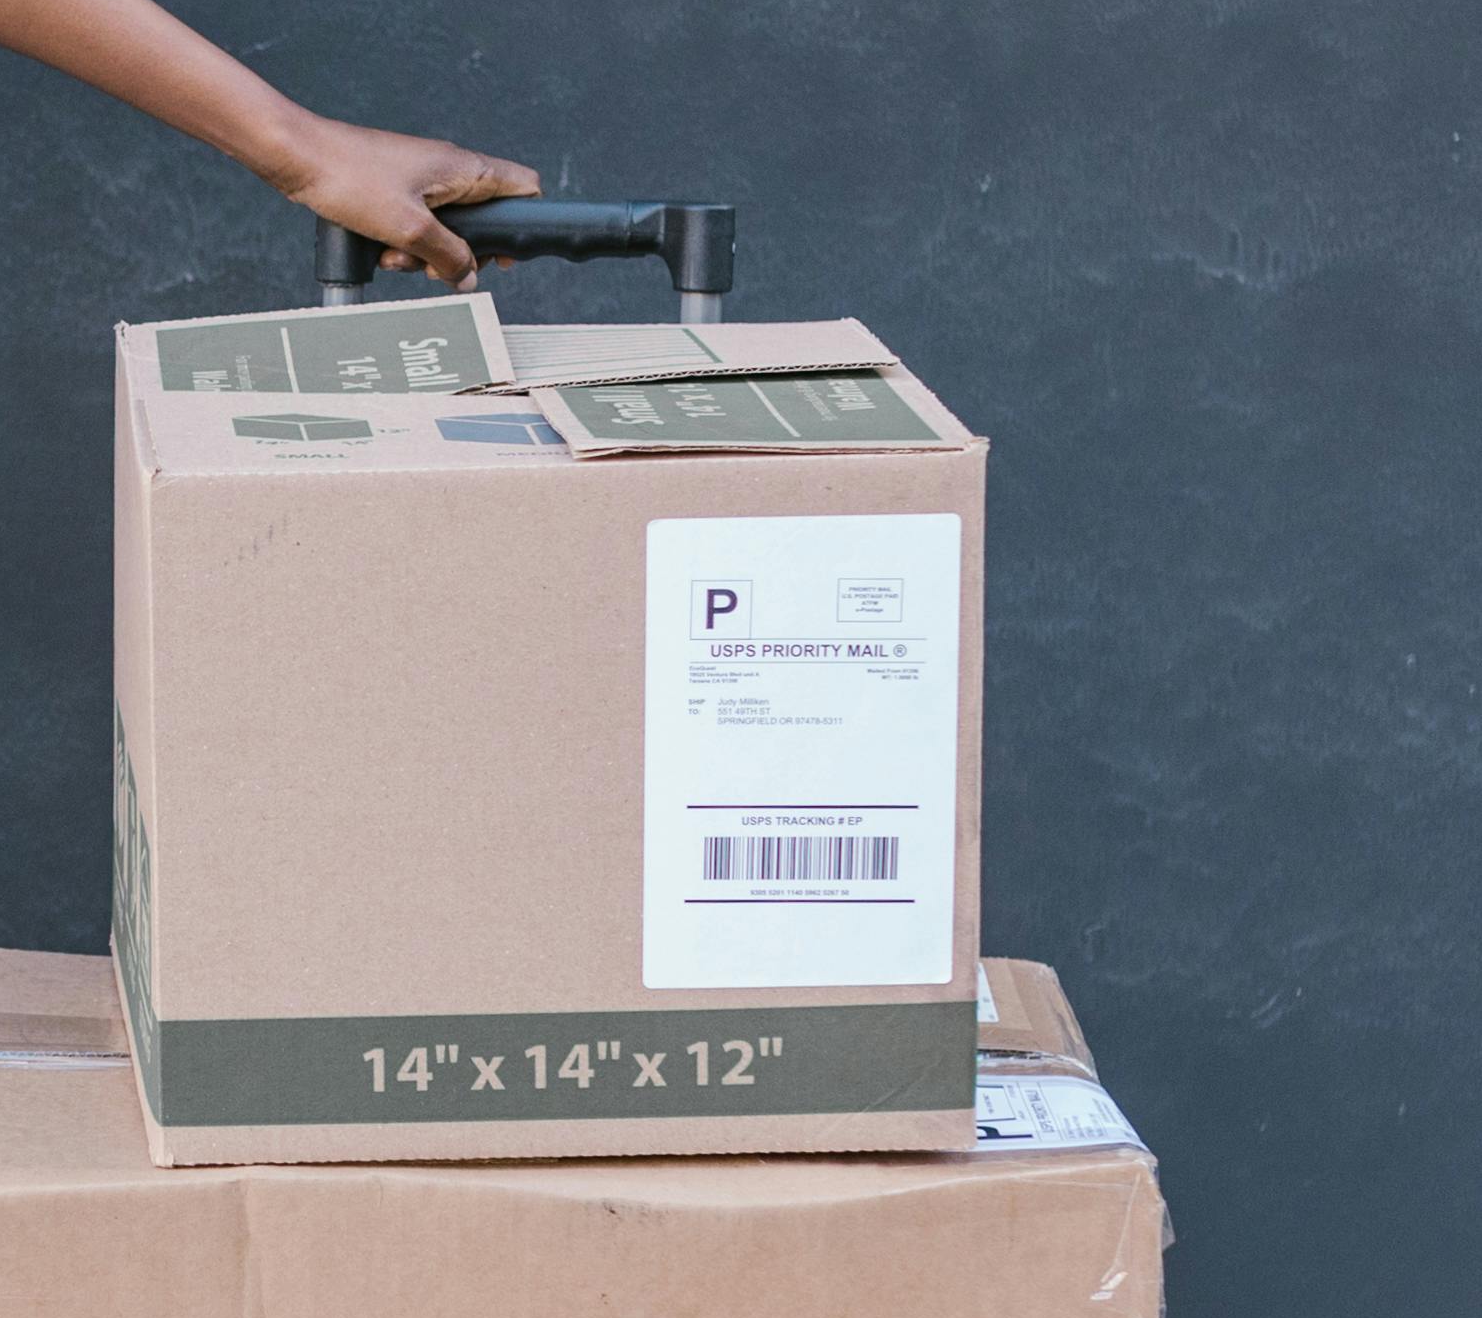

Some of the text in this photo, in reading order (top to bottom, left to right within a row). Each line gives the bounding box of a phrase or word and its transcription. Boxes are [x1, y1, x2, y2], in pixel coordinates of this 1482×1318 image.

[705, 588, 738, 630] P
[710, 644, 756, 658] USPS
[762, 644, 842, 657] PRIORITY
[847, 644, 888, 657] MAIL
[717, 698, 737, 707] Judy
[735, 707, 758, 715] 49TH
[759, 707, 771, 715] ST
[717, 717, 777, 725] SPRINGFIELD
[741, 816, 863, 825] USPS TRACKING # EP
[363, 1038, 784, 1092] 14" x 14" x 12"
